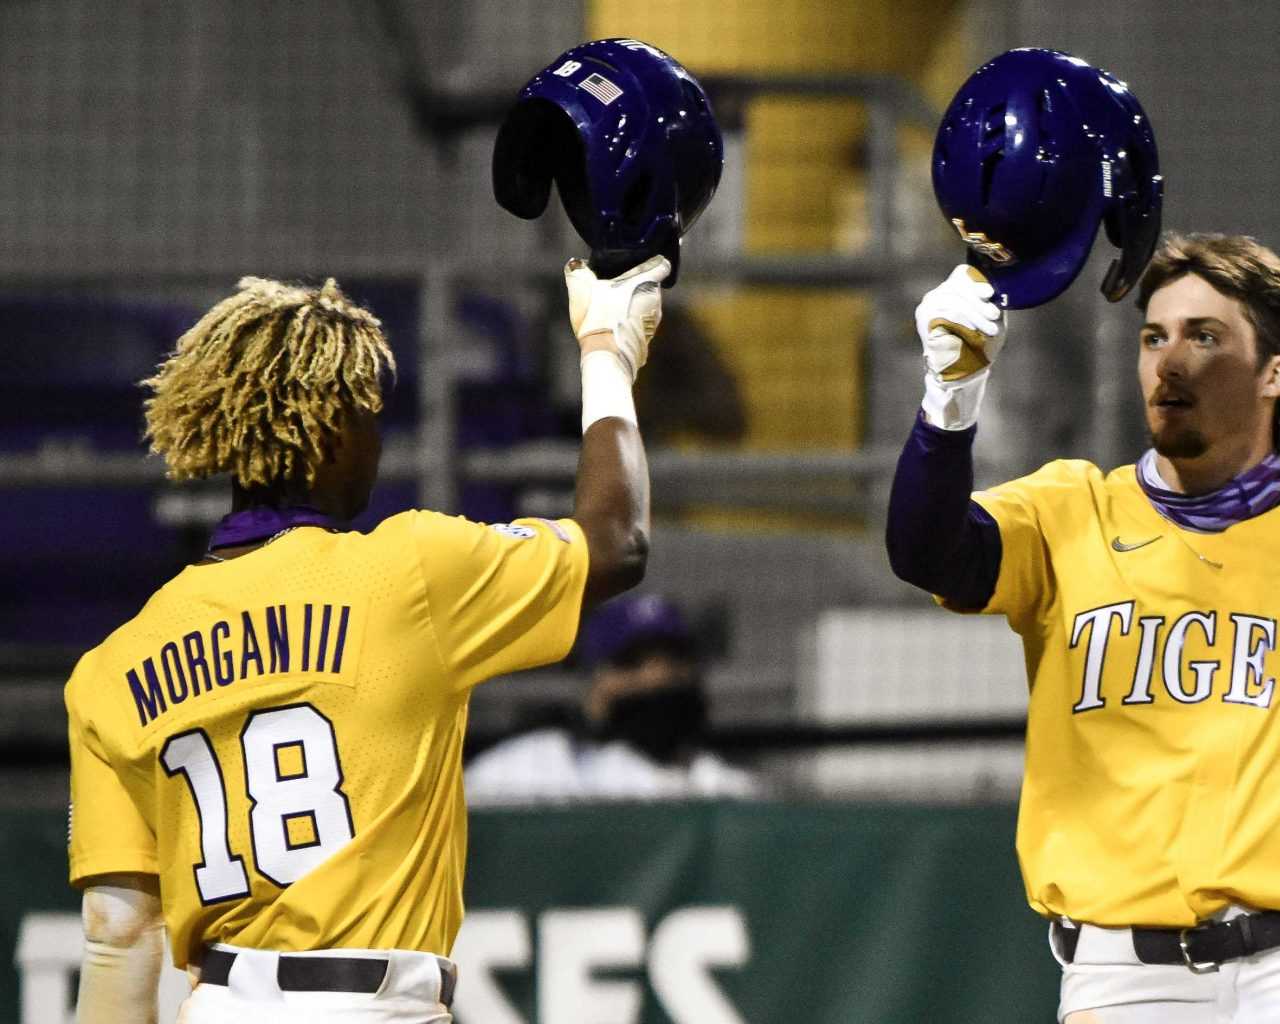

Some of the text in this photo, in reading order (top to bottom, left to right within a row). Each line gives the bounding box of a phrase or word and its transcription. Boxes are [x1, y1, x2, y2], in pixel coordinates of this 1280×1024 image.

[126, 604, 351, 727] MORGAN III
[159, 701, 356, 907] 18
